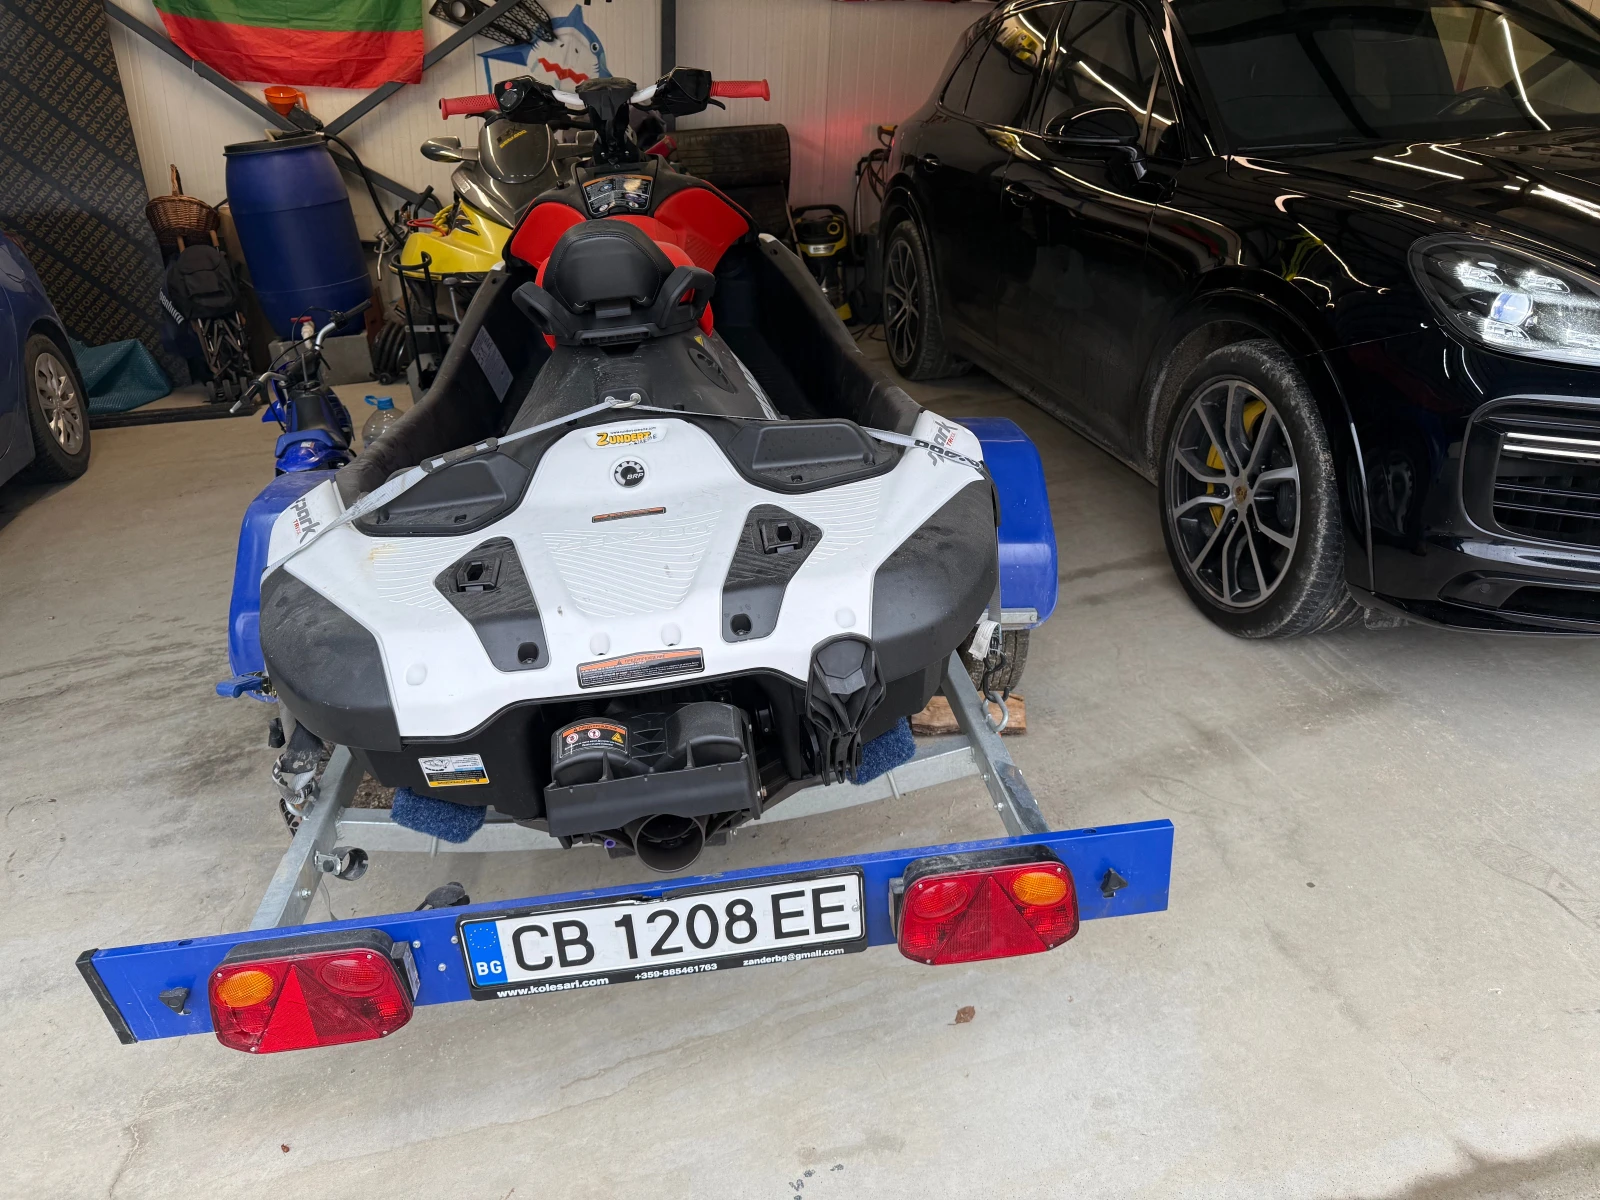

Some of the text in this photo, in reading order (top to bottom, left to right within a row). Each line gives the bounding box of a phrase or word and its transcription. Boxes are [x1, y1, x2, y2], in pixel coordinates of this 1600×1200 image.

[0, 18, 26, 51] YFORM
[43, 0, 72, 30] SKYFO
[62, 2, 101, 45] SKYFORM
[0, 25, 36, 69] SKYFORM
[7, 33, 46, 77] SKYFORM
[17, 41, 56, 84] SKYFORM
[82, 29, 110, 60] SKYFO
[27, 48, 66, 92] SKYFORM
[37, 56, 75, 99] SKYFORM
[46, 63, 85, 106] SKYFORM
[56, 71, 94, 114] SKYFORM
[66, 78, 104, 121] SKYFORM
[75, 85, 113, 128] SKYFORM
[0, 95, 30, 135] KYFORM
[2, 102, 40, 145] SKYFORM
[12, 109, 50, 152] SKYFORM
[85, 93, 122, 135] SKYFORM
[103, 119, 131, 149] SKYFO
[21, 116, 59, 159] SKYFORM
[31, 124, 69, 166] SKYFORM
[41, 131, 78, 173] SKYFORM
[50, 138, 88, 180] SKYFORM
[60, 145, 97, 187] SKYFORM
[69, 152, 106, 194] SKYFORM
[5, 176, 43, 218] SKYFORM
[78, 159, 116, 201] SKYFORM
[88, 166, 125, 208] SKYFORM
[97, 173, 134, 214] SKYFORM
[106, 180, 143, 221] SKYFORM
[15, 183, 52, 224] SKYFORM
[24, 189, 62, 231] SKYFORM
[34, 196, 71, 238] SKYFORM
[43, 203, 81, 245] SKYFORM
[53, 210, 90, 251] SKYFORM
[62, 217, 99, 258] SKYFORM
[71, 223, 108, 264] SKYFORM
[81, 230, 117, 271] SKYFORM
[41, 261, 65, 286] FORM
[90, 237, 126, 277] SKYFORM
[99, 243, 135, 284] SKYFORM
[108, 250, 144, 290] SKYFORM
[46, 267, 74, 298] YFORM
[50, 274, 83, 309] KYFORM
[65, 287, 101, 327] SKYFORM
[74, 293, 110, 333] SKYFORM
[83, 299, 119, 339] SKYFORM
[92, 306, 128, 346] SKYFORM
[110, 312, 137, 342] YFORM
[596, 432, 652, 446] ZUNDERT
[626, 472, 644, 480] BRP
[511, 884, 850, 971] CB 1208 EE
[475, 960, 503, 977] BG
[742, 946, 845, 967] zanderbg@gmail.com
